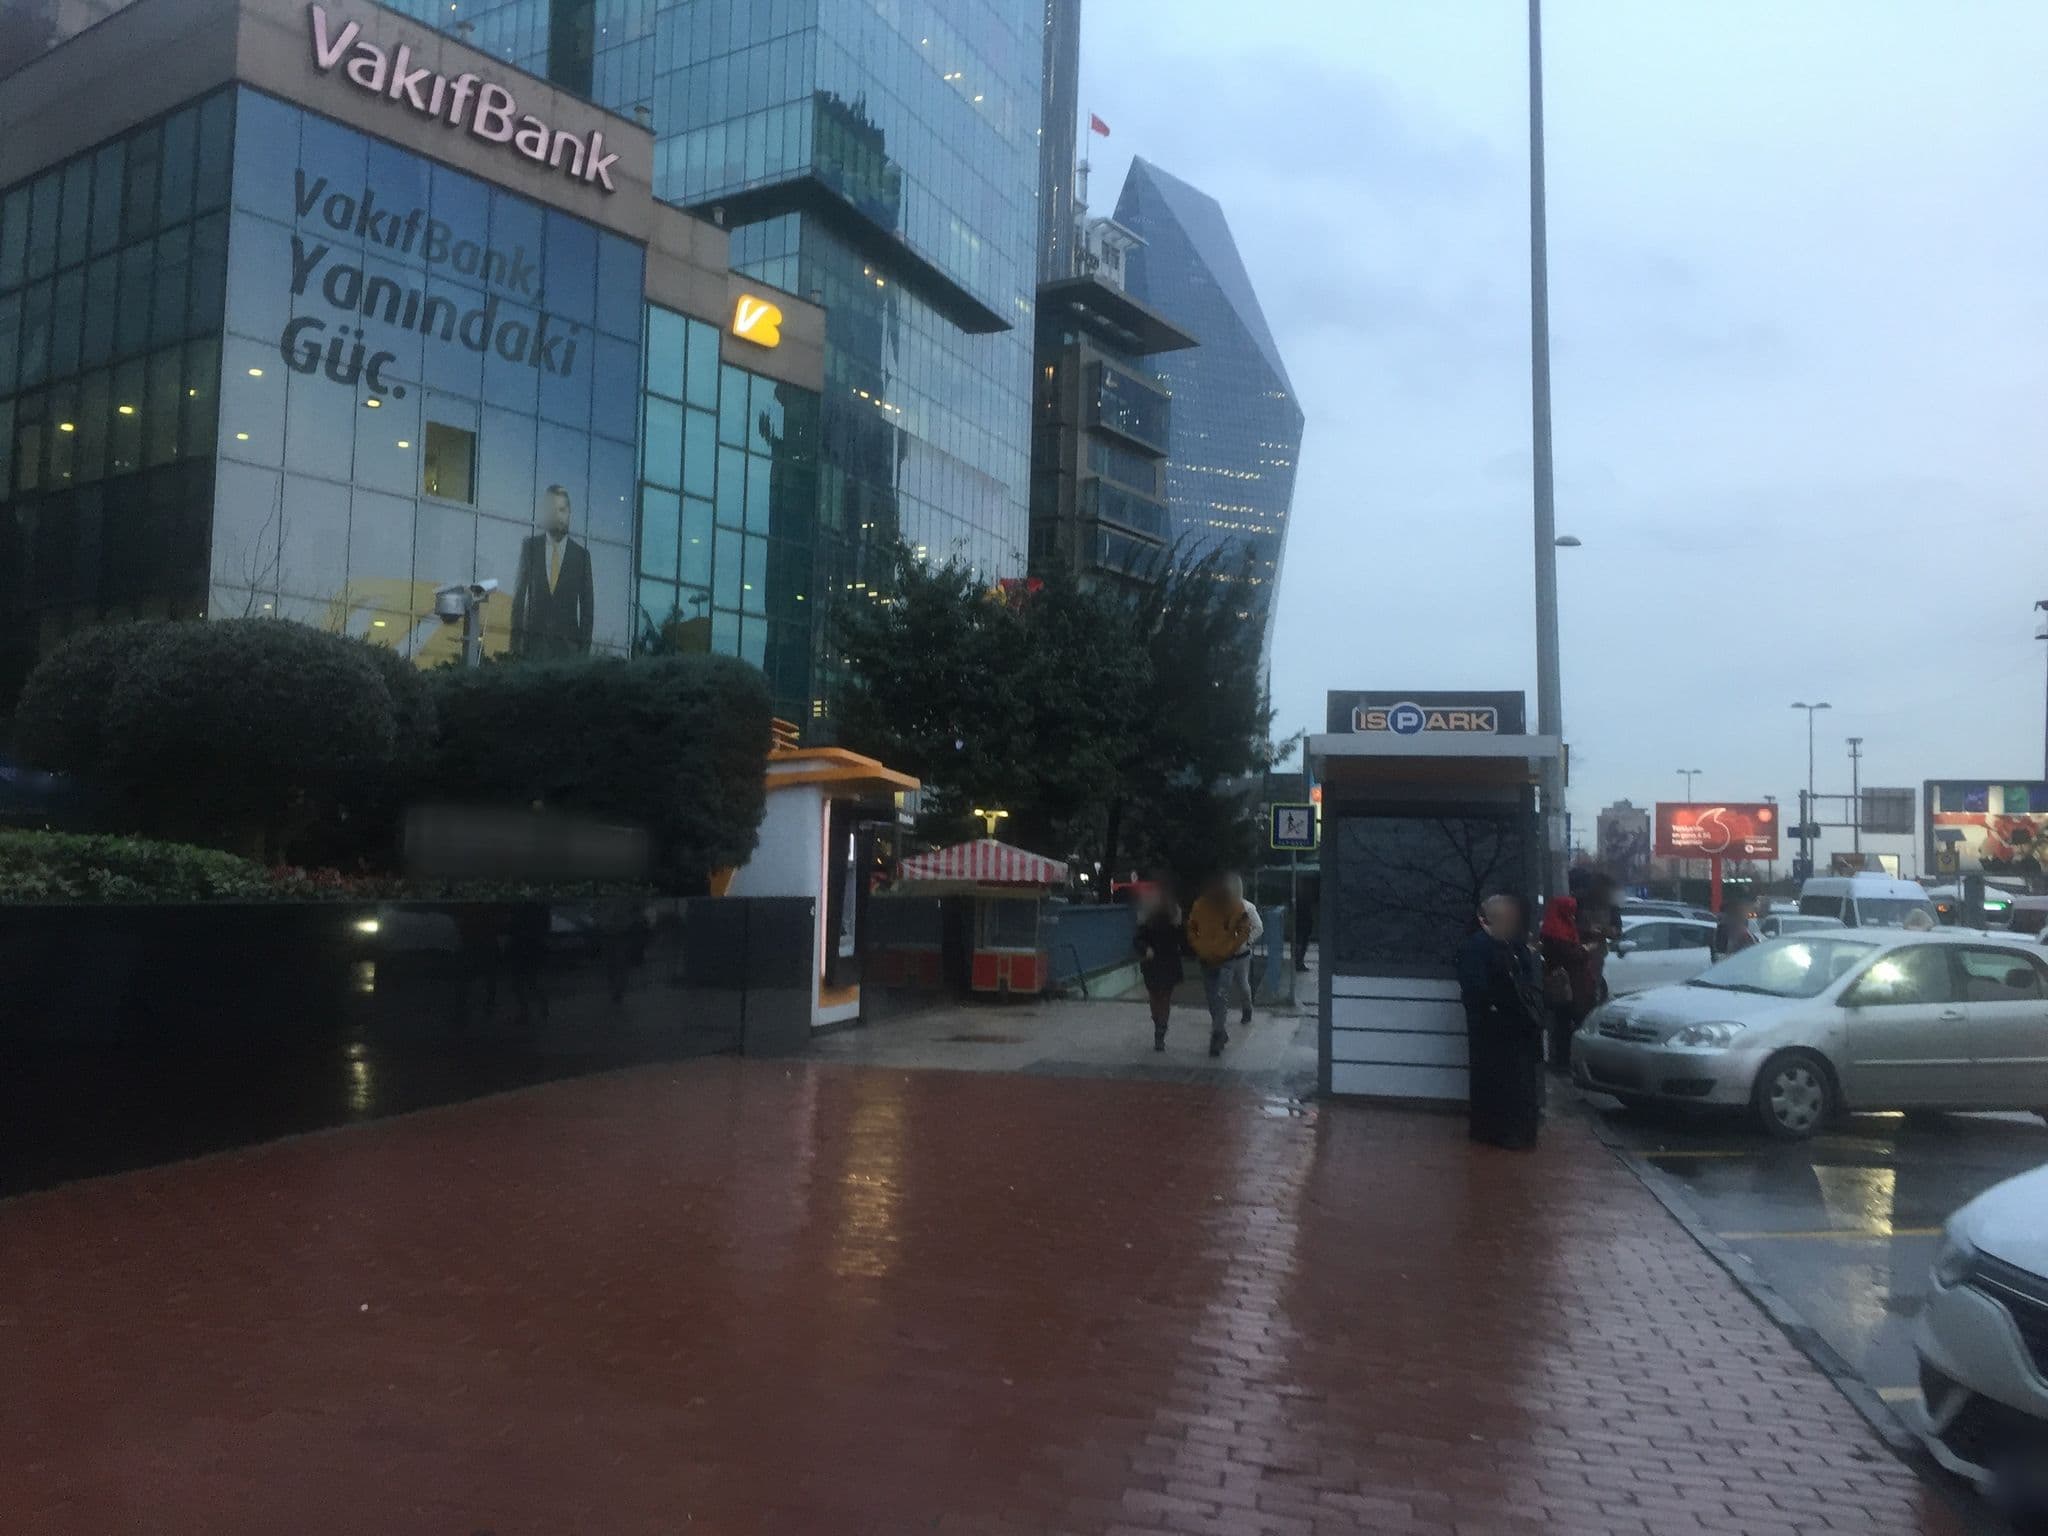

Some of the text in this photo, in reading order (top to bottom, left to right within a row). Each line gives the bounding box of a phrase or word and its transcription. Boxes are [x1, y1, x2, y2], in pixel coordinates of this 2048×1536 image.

[309, 5, 622, 193] VakıfBank
[280, 316, 407, 400] Güç.
[289, 234, 579, 379] Yanındaki
